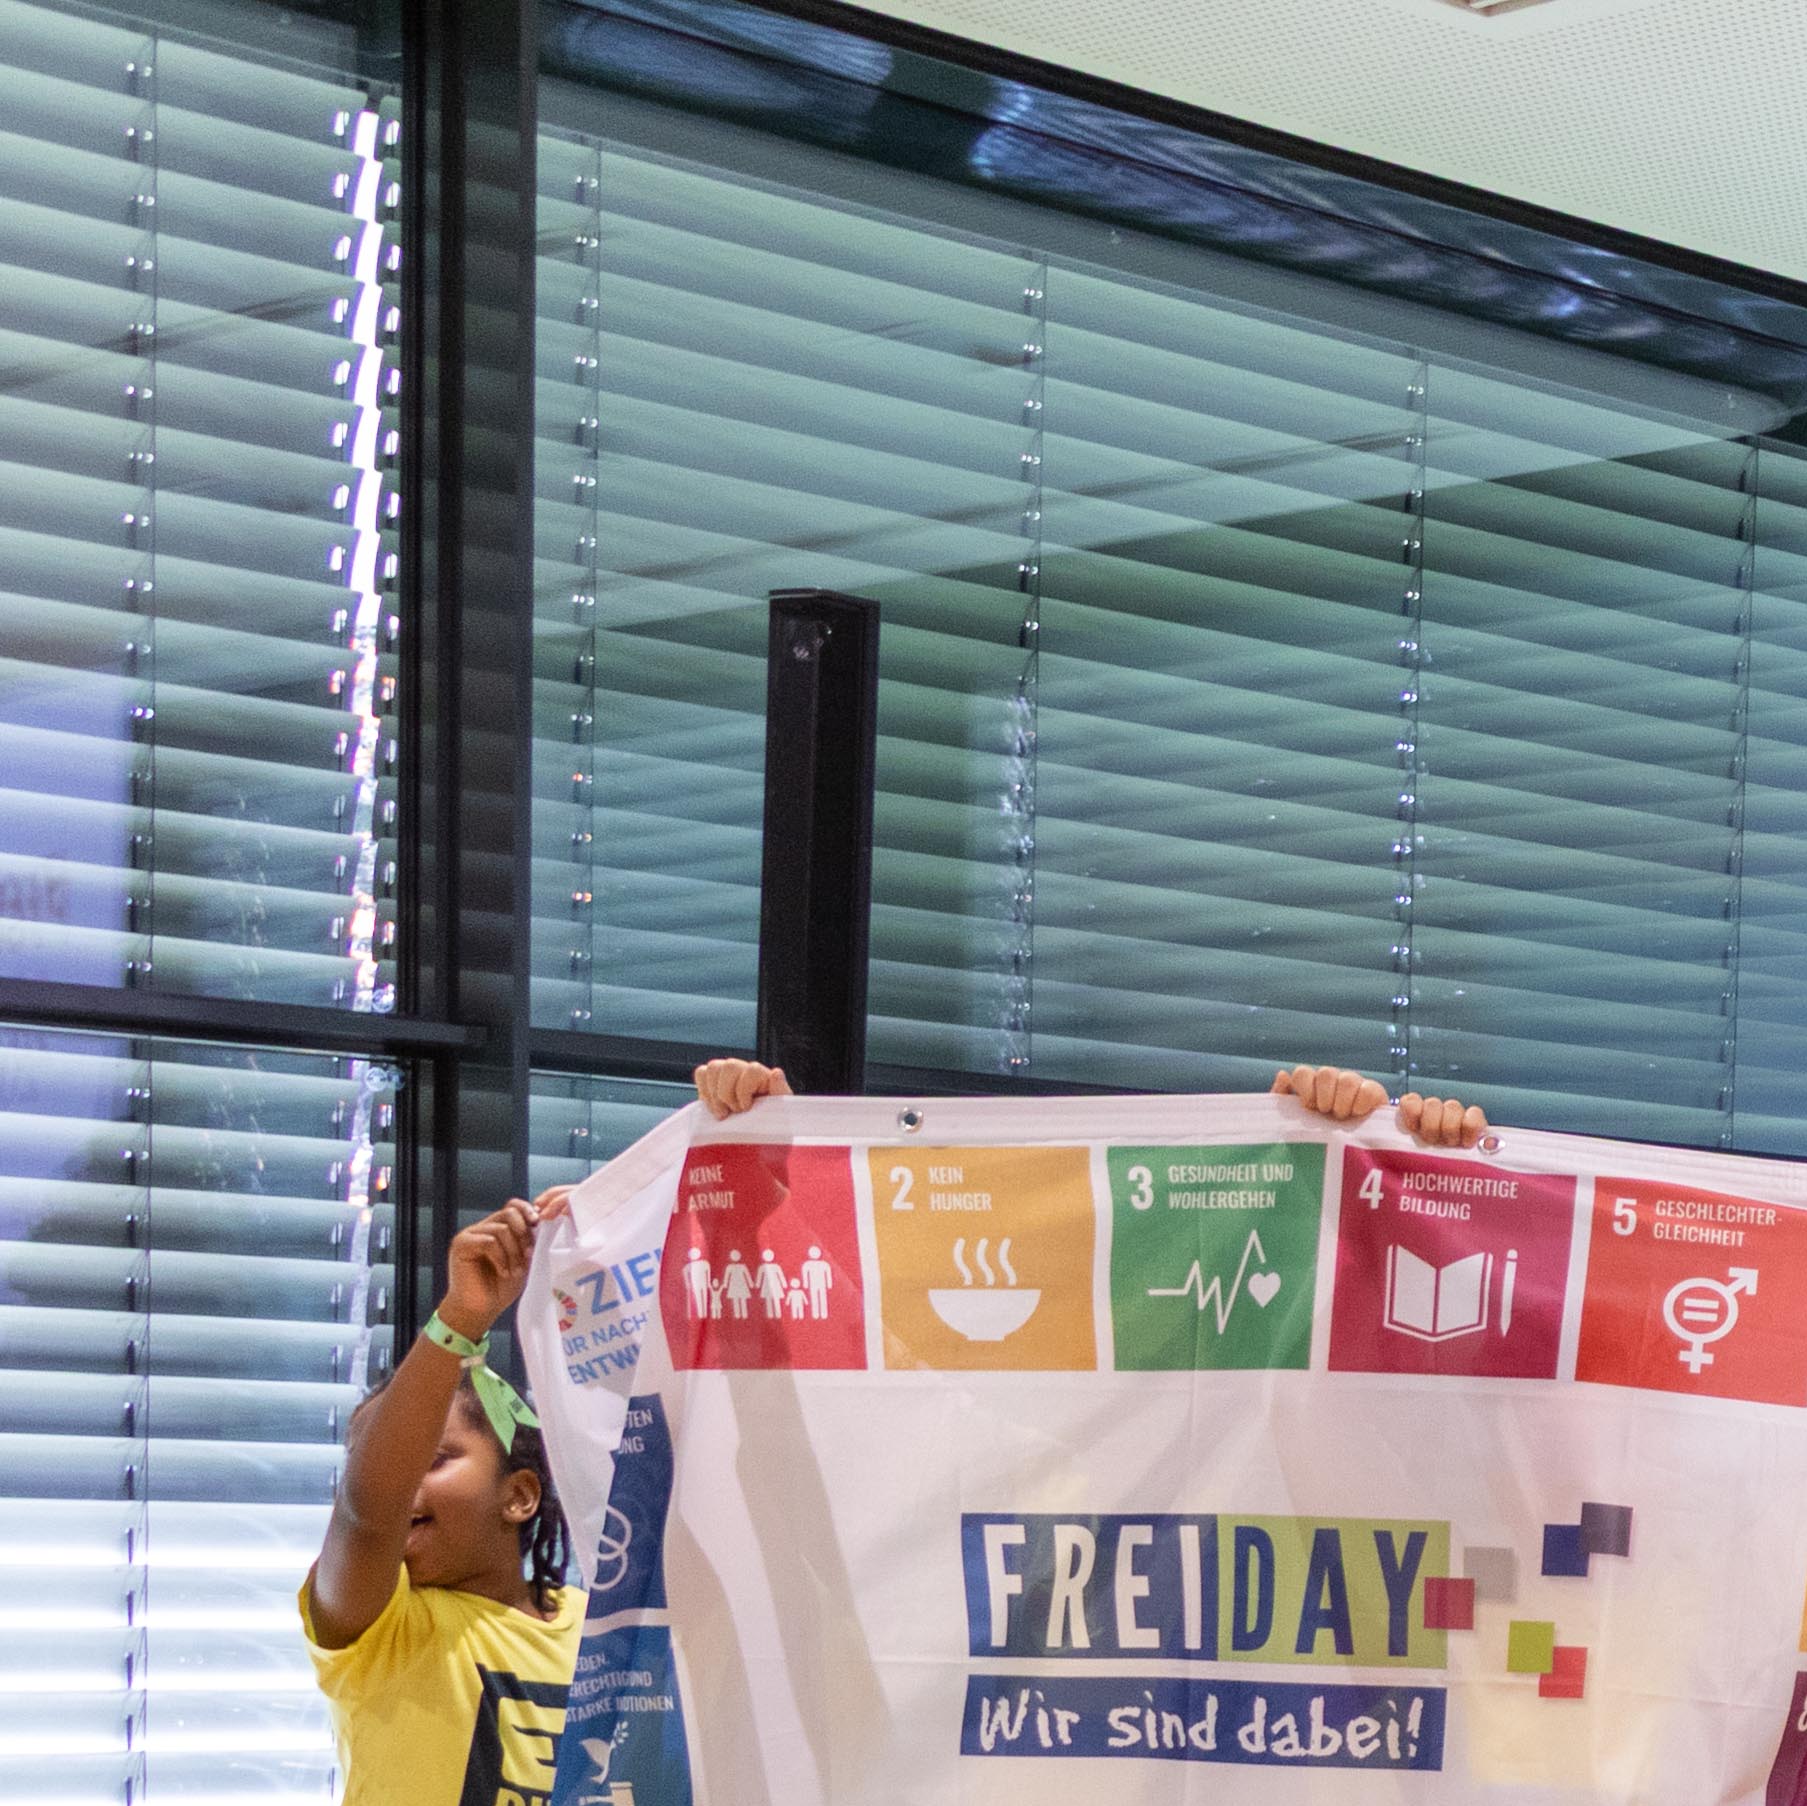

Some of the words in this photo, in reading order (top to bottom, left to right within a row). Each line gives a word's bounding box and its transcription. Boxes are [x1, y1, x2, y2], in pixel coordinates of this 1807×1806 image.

[929, 1167, 964, 1185] KEIN
[1168, 1165, 1258, 1184] GESUNDHEIT
[1262, 1164, 1294, 1182] UND
[1402, 1172, 1518, 1199] HOCHWERTIGE
[688, 1191, 735, 1211] ARMUT
[889, 1166, 914, 1211] 2
[1128, 1166, 1154, 1210] 3
[1168, 1191, 1276, 1210] WOHLERGEHEN
[1359, 1169, 1384, 1210] 4
[930, 1192, 992, 1211] HUNGER
[1399, 1195, 1471, 1220] BILDUNG
[1655, 1200, 1783, 1226] GESCHLECHTER-
[1612, 1198, 1637, 1236] 5
[1653, 1222, 1745, 1248] GLEICHHEIT
[979, 1688, 1080, 1753] Wir
[1107, 1690, 1218, 1751] sind
[1237, 1694, 1425, 1761] dabei!
